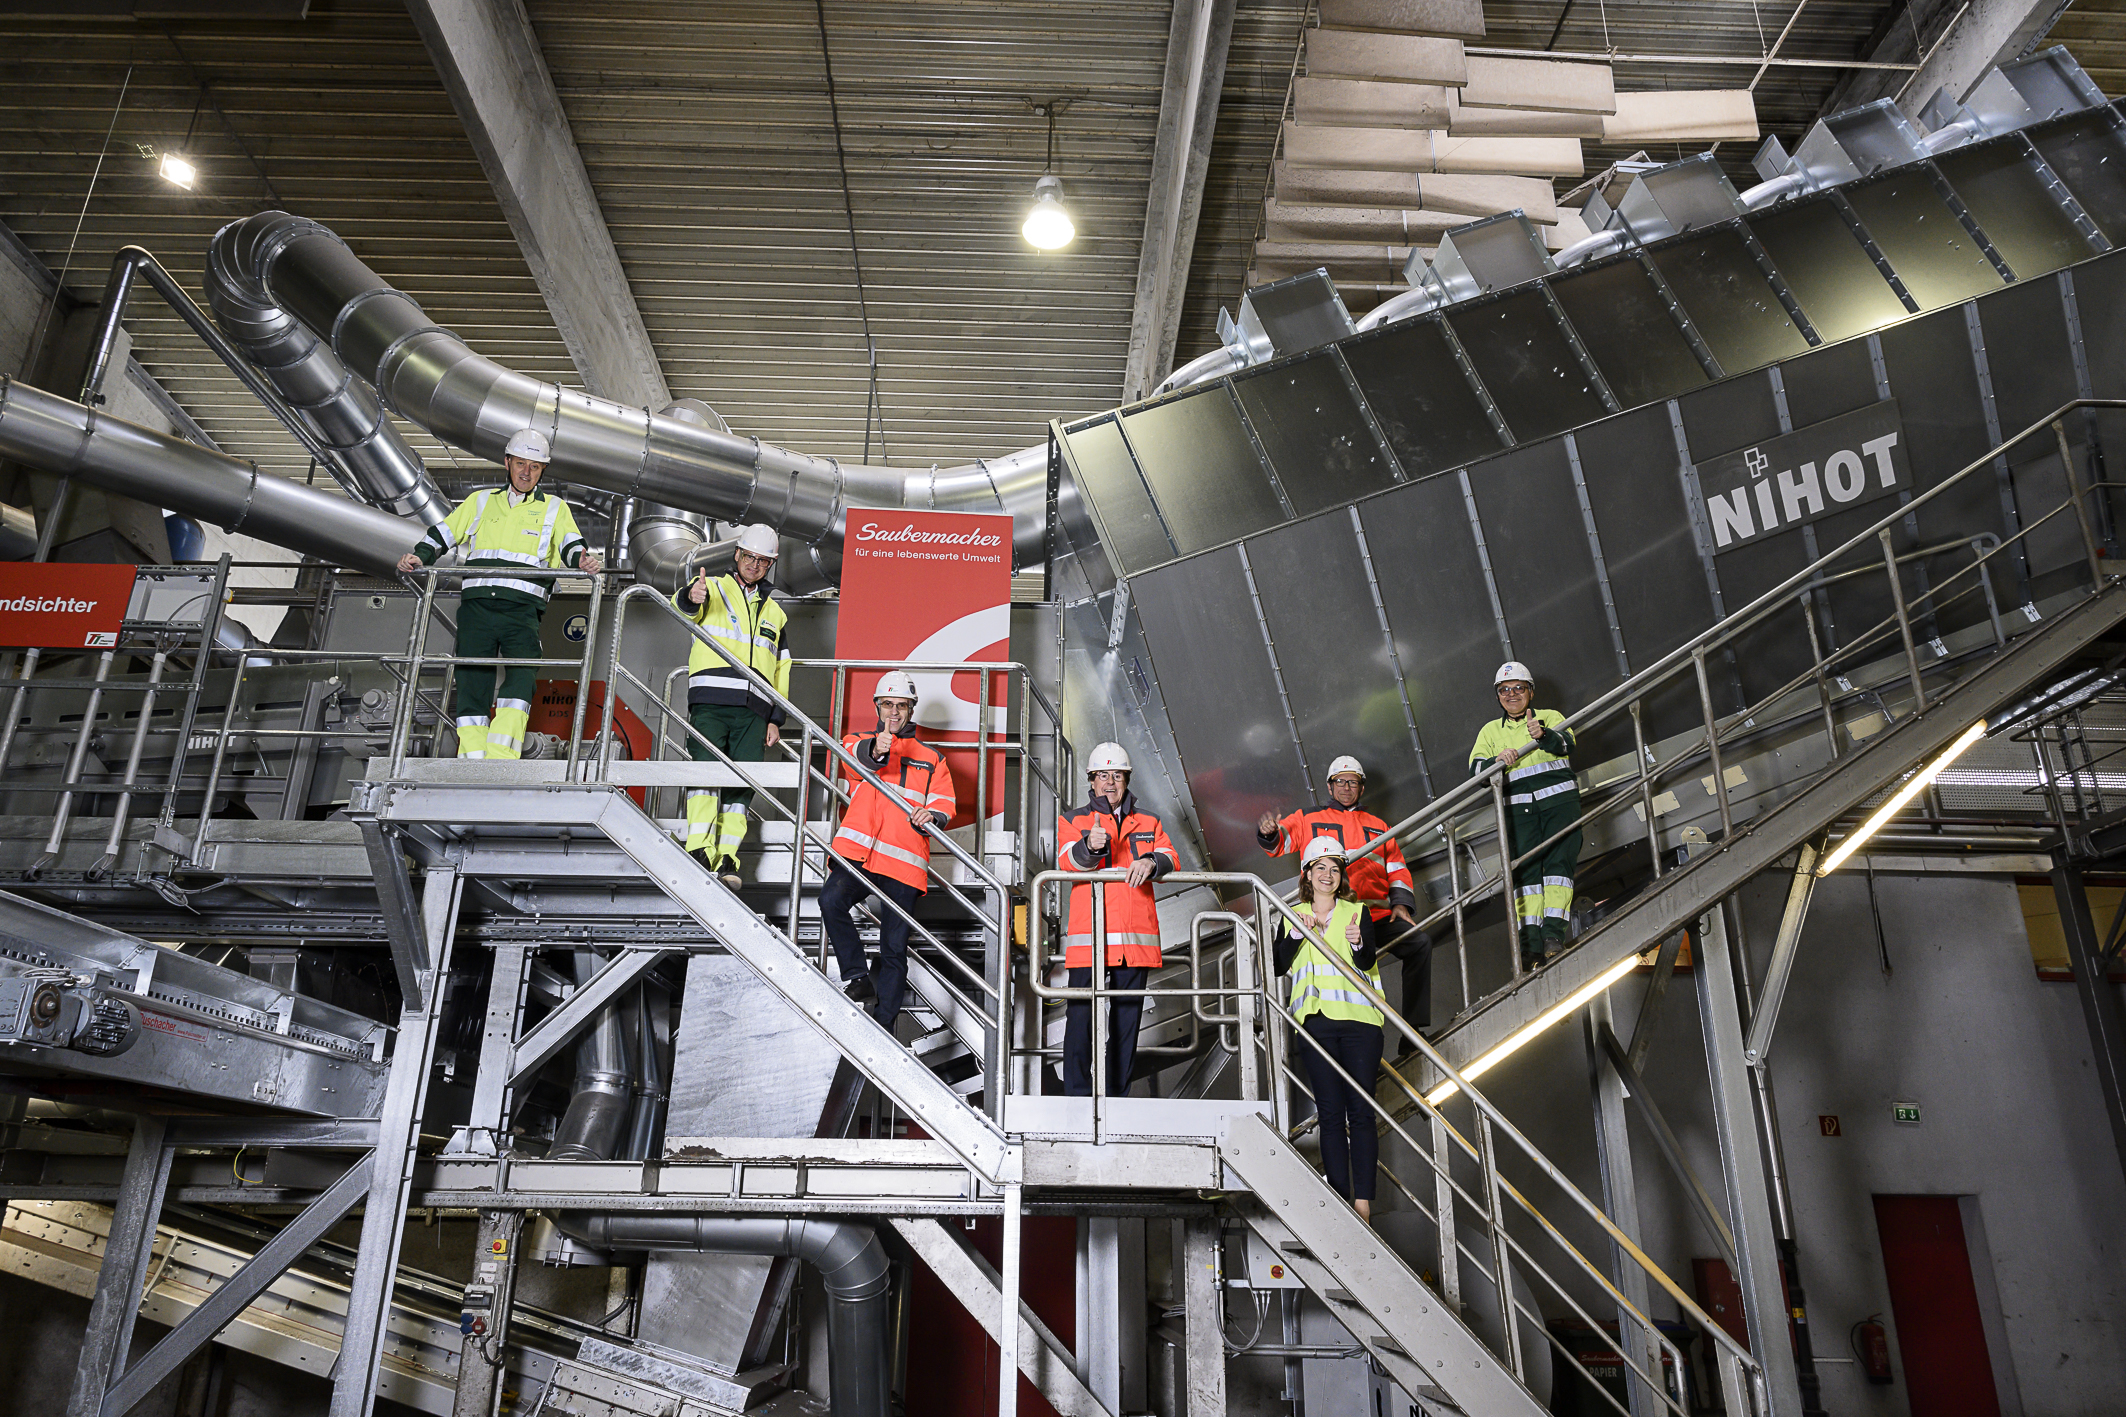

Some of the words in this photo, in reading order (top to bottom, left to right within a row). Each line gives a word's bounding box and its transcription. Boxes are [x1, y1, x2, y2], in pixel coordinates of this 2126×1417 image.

[1707, 431, 1897, 548] NIHOT
[856, 523, 1001, 546] Saubermacher
[855, 548, 869, 556] für
[872, 549, 894, 558] eine
[897, 550, 959, 560] lebenswerte
[962, 553, 1001, 563] Umwelt
[542, 695, 577, 705] NIHO
[1589, 1367, 1617, 1377] PAPIER
